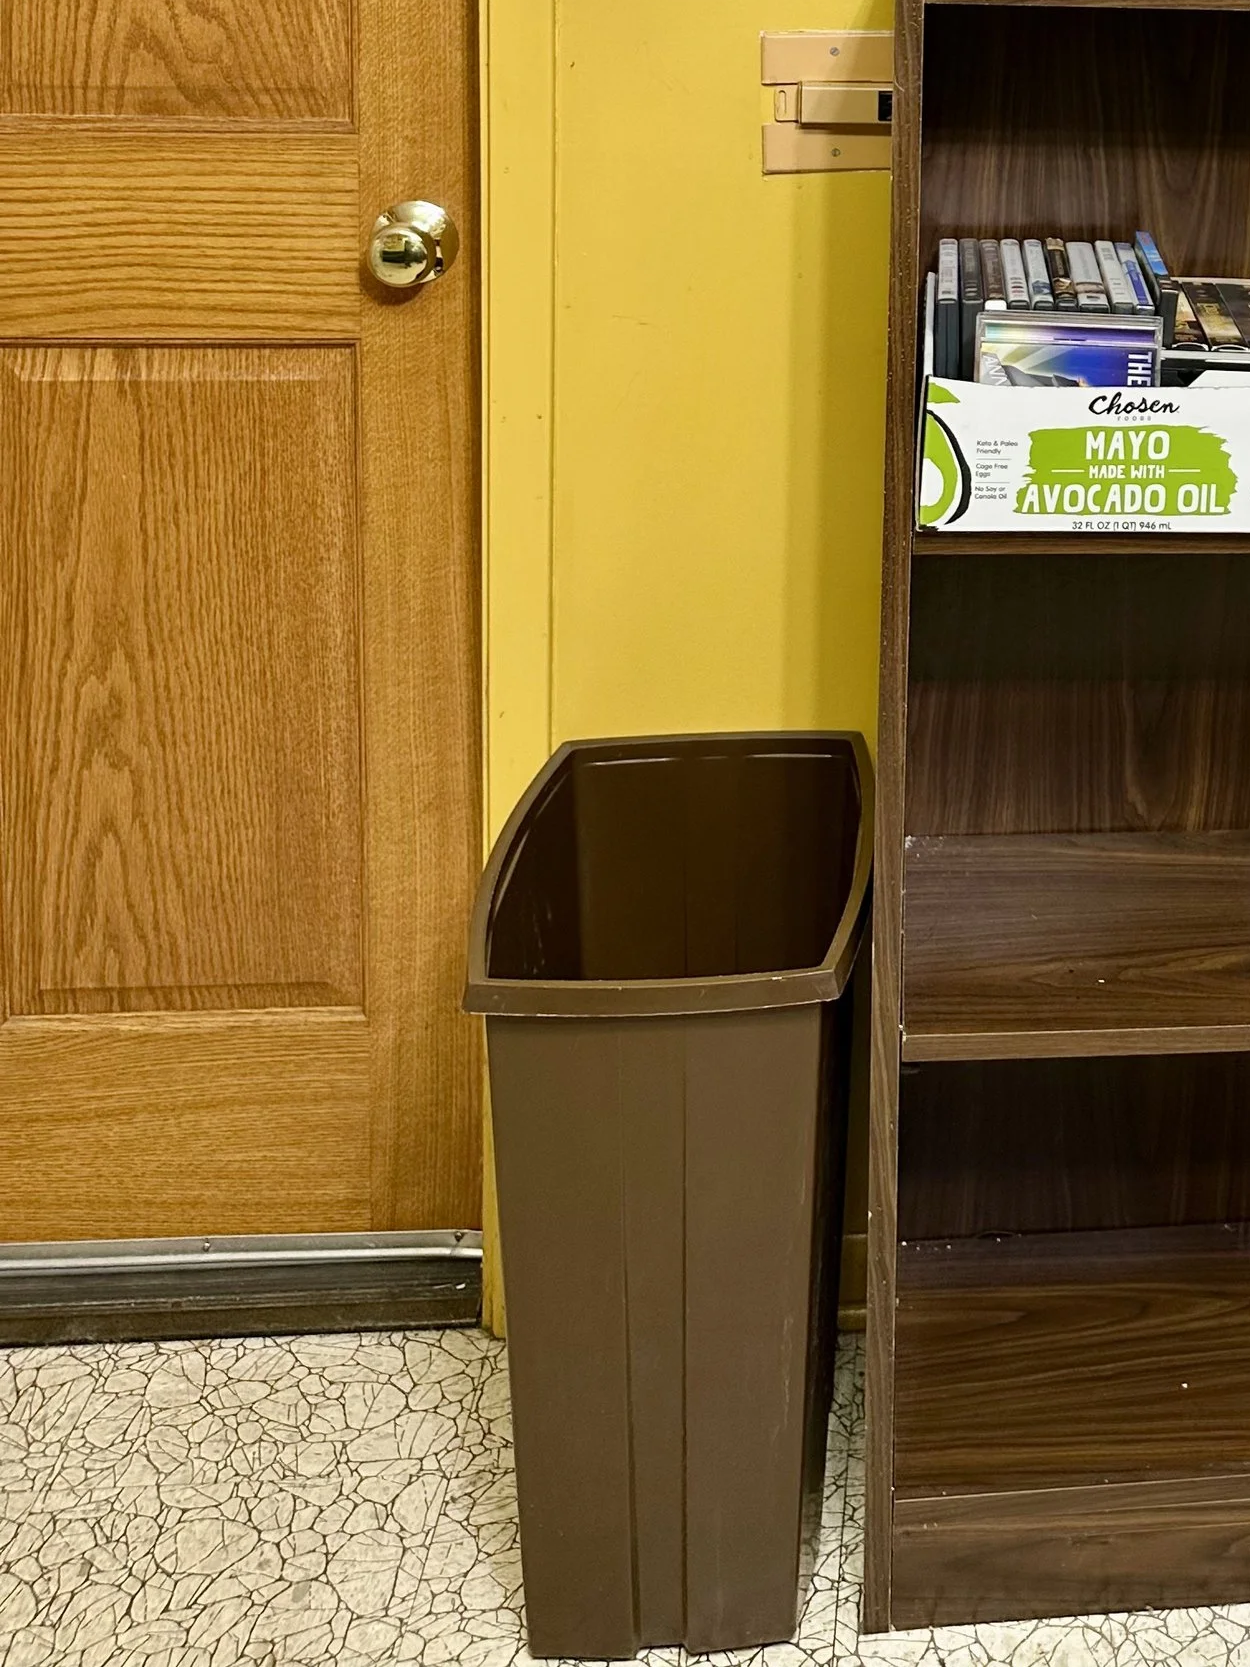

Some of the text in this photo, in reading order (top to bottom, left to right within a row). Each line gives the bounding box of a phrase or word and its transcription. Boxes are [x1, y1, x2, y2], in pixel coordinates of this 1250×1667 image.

[1127, 351, 1152, 387] THE
[1088, 391, 1180, 415] Chosen
[1085, 430, 1170, 461] MAYO
[1089, 464, 1165, 479] MADE WITH
[1021, 483, 1225, 514] AVOCADO OIL
[1072, 521, 1083, 530] 32
[1085, 521, 1095, 530] FL
[1097, 521, 1110, 530] OZ
[1139, 521, 1156, 530] 946
